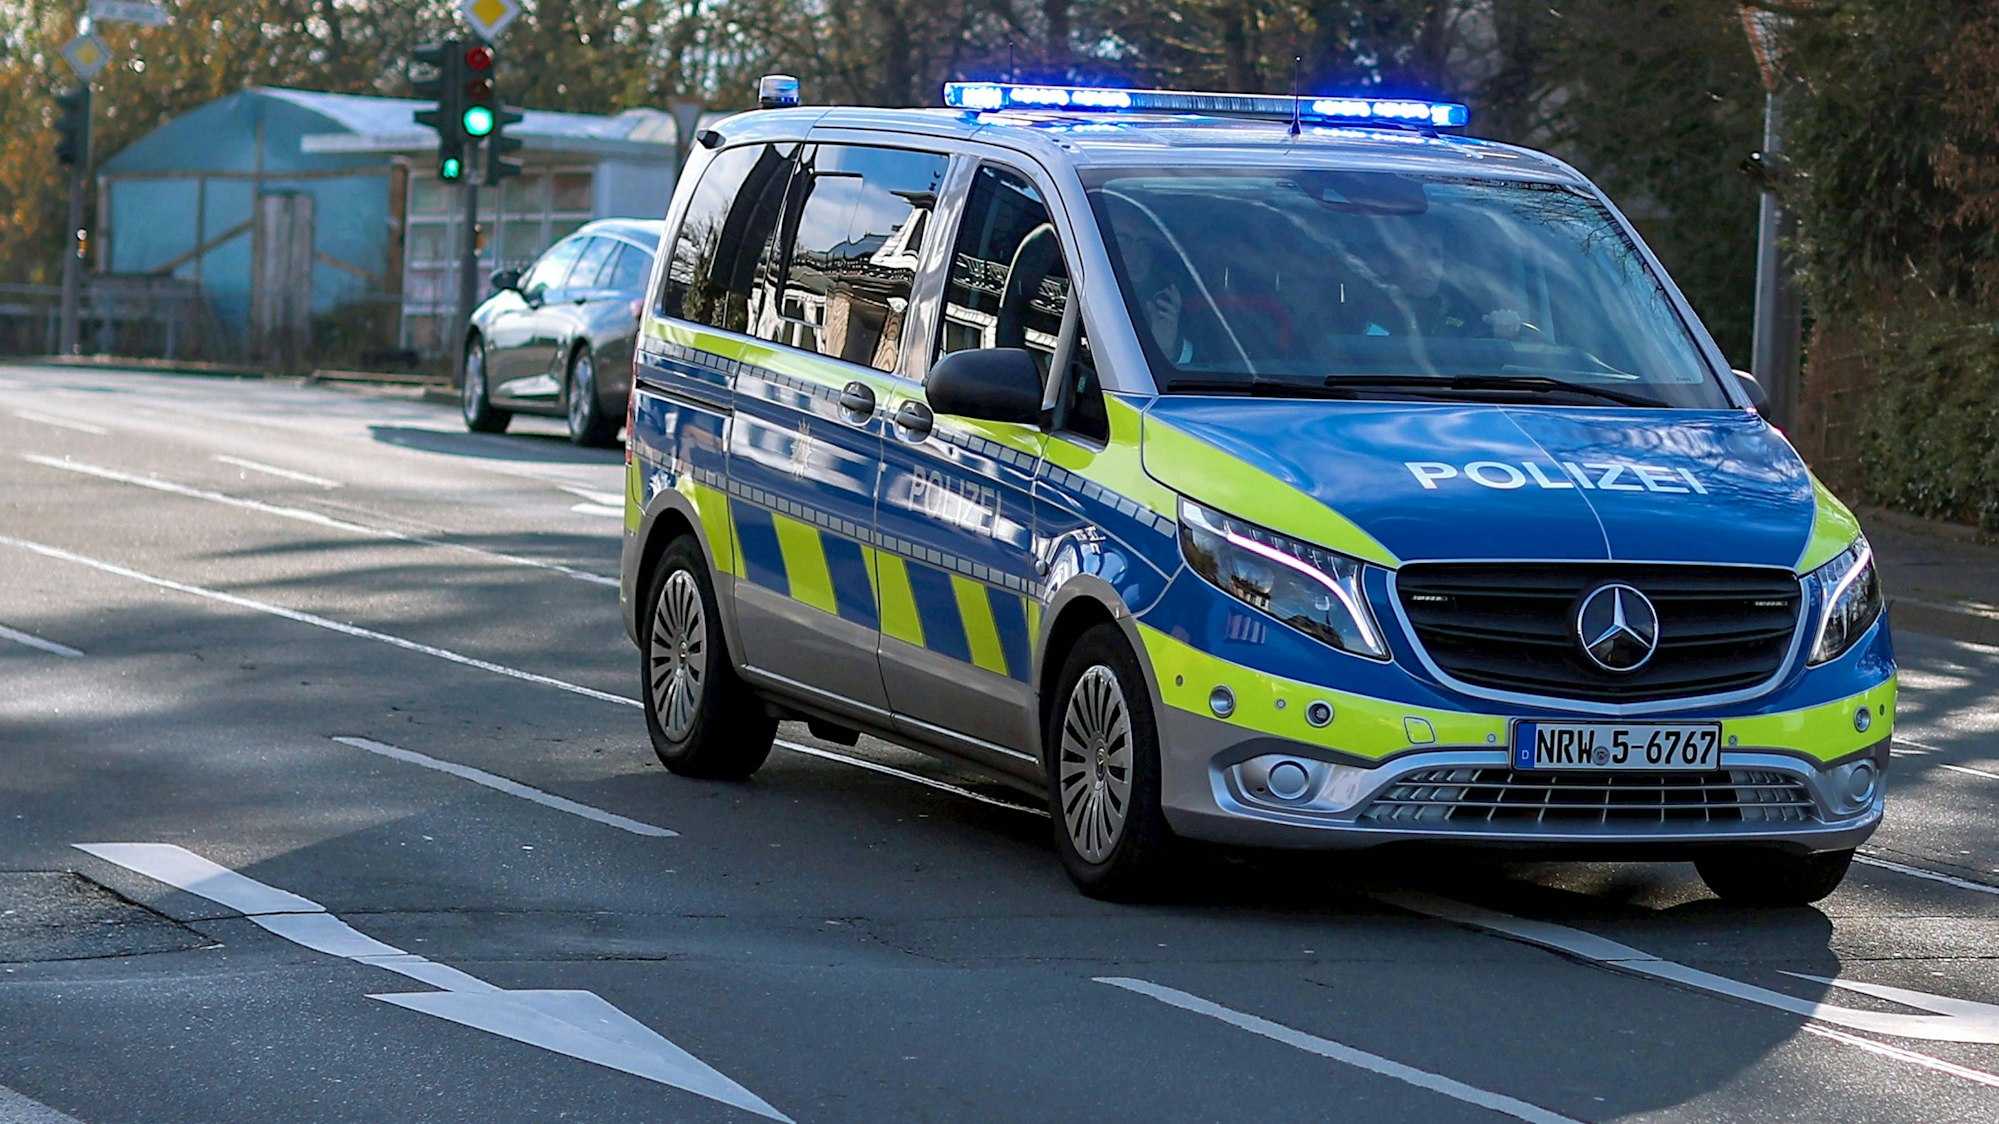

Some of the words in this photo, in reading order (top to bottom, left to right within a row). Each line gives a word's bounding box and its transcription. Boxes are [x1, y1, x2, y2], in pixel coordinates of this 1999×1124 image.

[1404, 461, 1708, 495] POLIZEI
[908, 464, 1001, 538] POLIZEI
[1521, 750, 1530, 760] D
[1536, 729, 1595, 764] NRW
[1612, 730, 1717, 765] 5-6767
